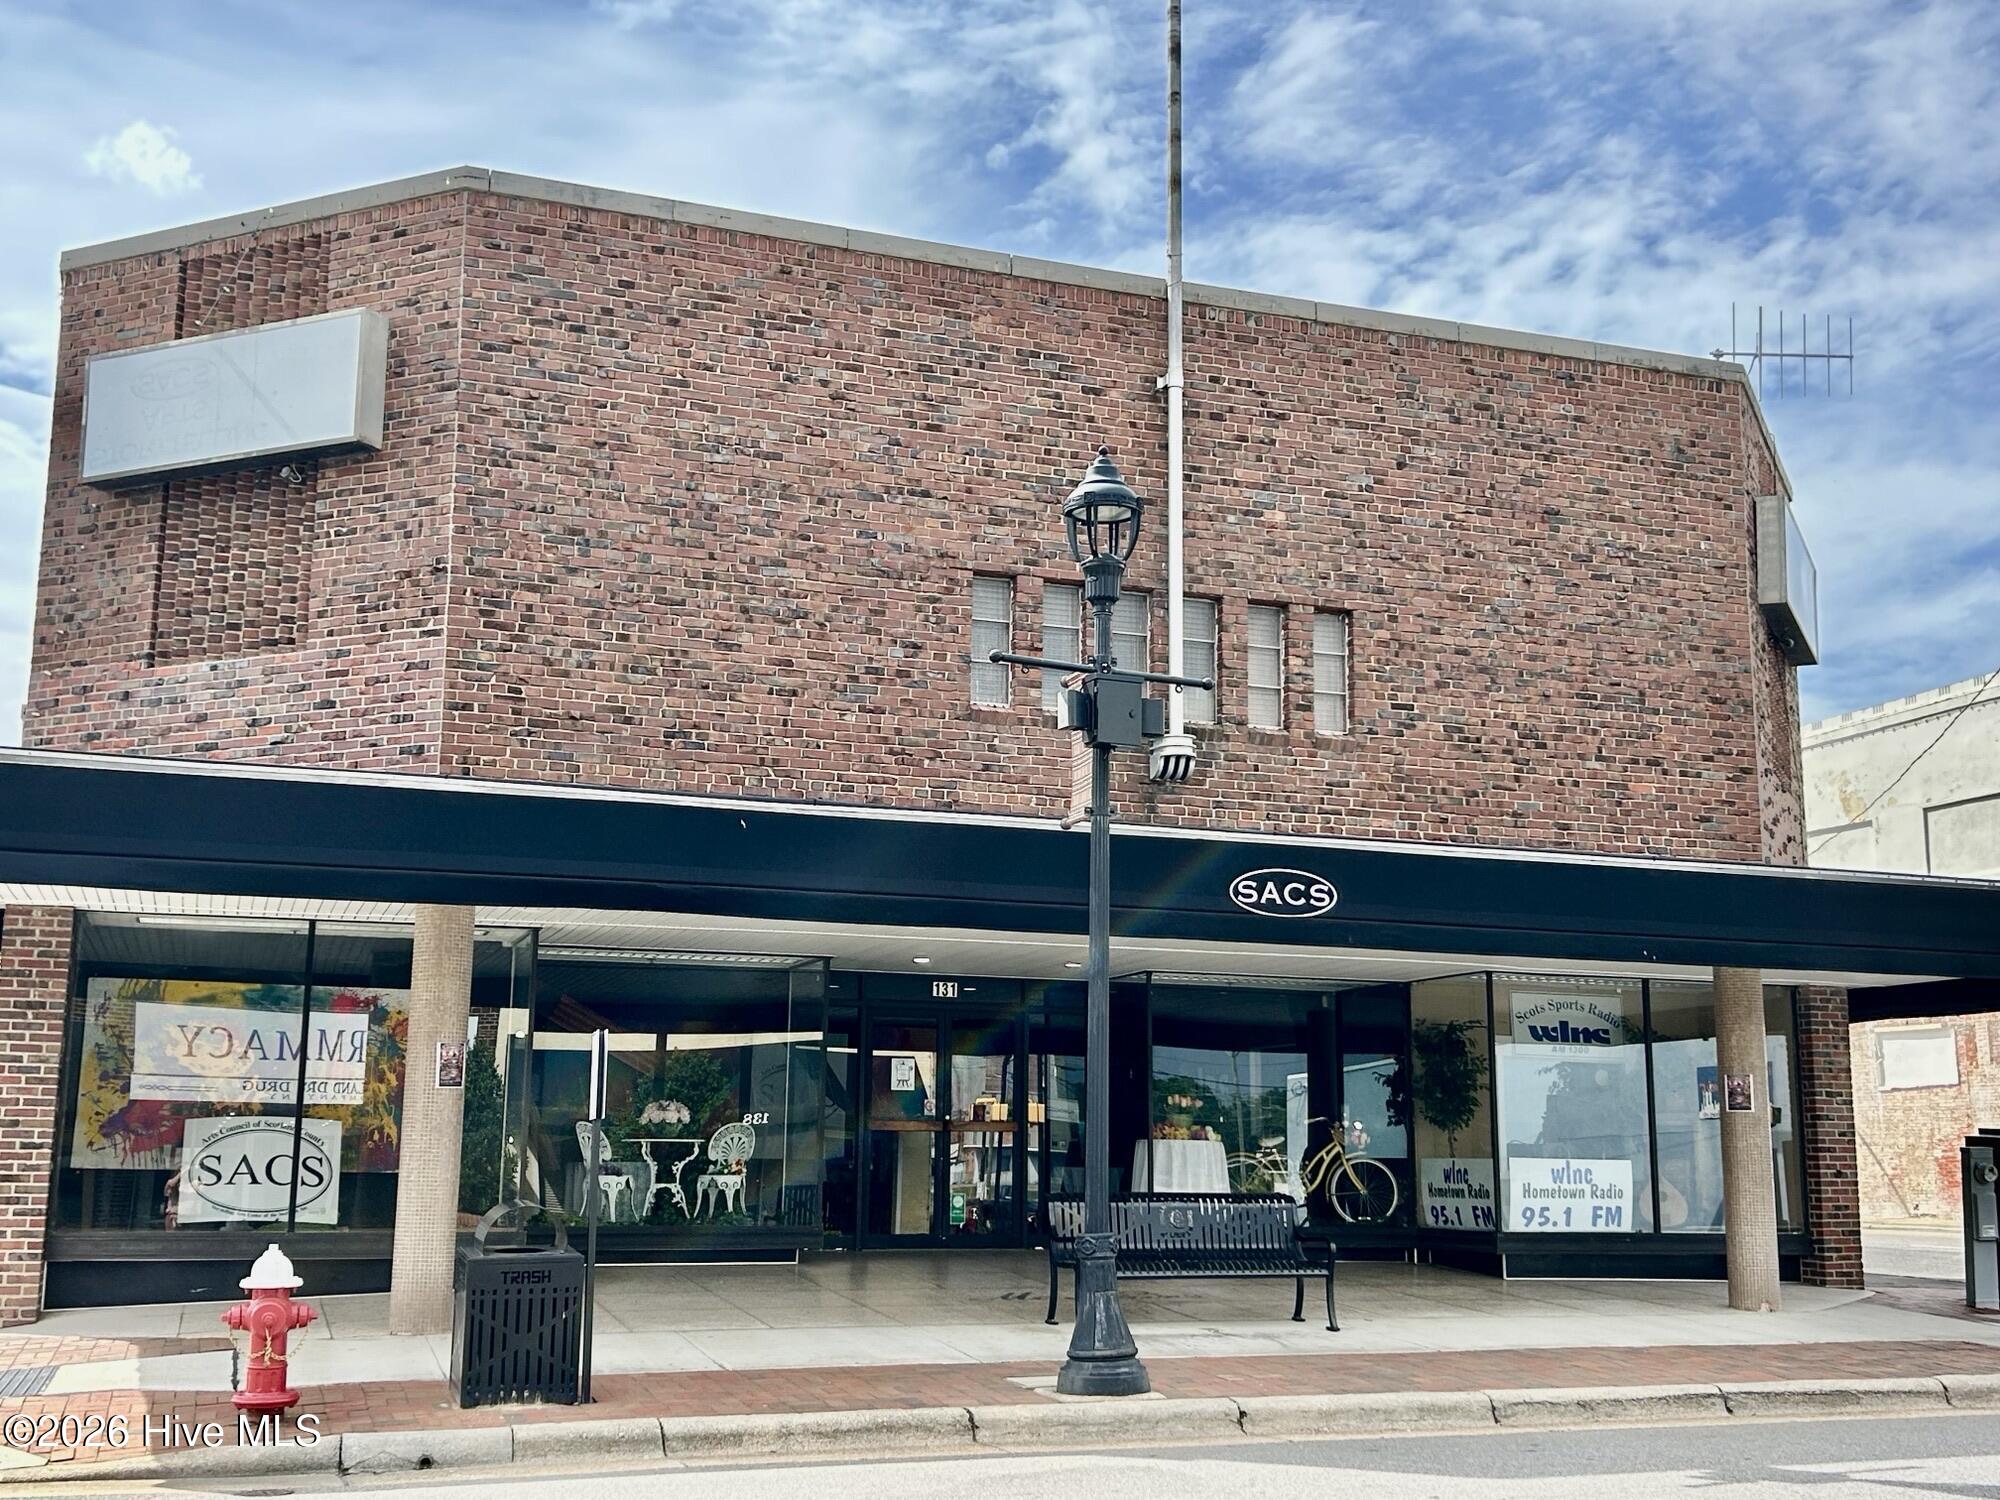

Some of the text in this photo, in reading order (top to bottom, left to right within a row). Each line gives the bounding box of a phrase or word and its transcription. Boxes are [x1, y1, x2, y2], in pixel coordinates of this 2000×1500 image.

[1237, 880, 1330, 907] SACS
[934, 982, 956, 997] 131
[1515, 999, 1620, 1029] Scots Sports Radio
[202, 1131, 219, 1146] Arts
[220, 1121, 251, 1135] Council
[198, 1153, 325, 1189] SACS
[1428, 1183, 1490, 1200] Hometown Radio
[1523, 1183, 1624, 1200] Hometown Radio
[1431, 1205, 1495, 1228] 95.1 FM
[1521, 1206, 1622, 1228] 95.1 FM
[500, 1270, 551, 1285] TRASH
